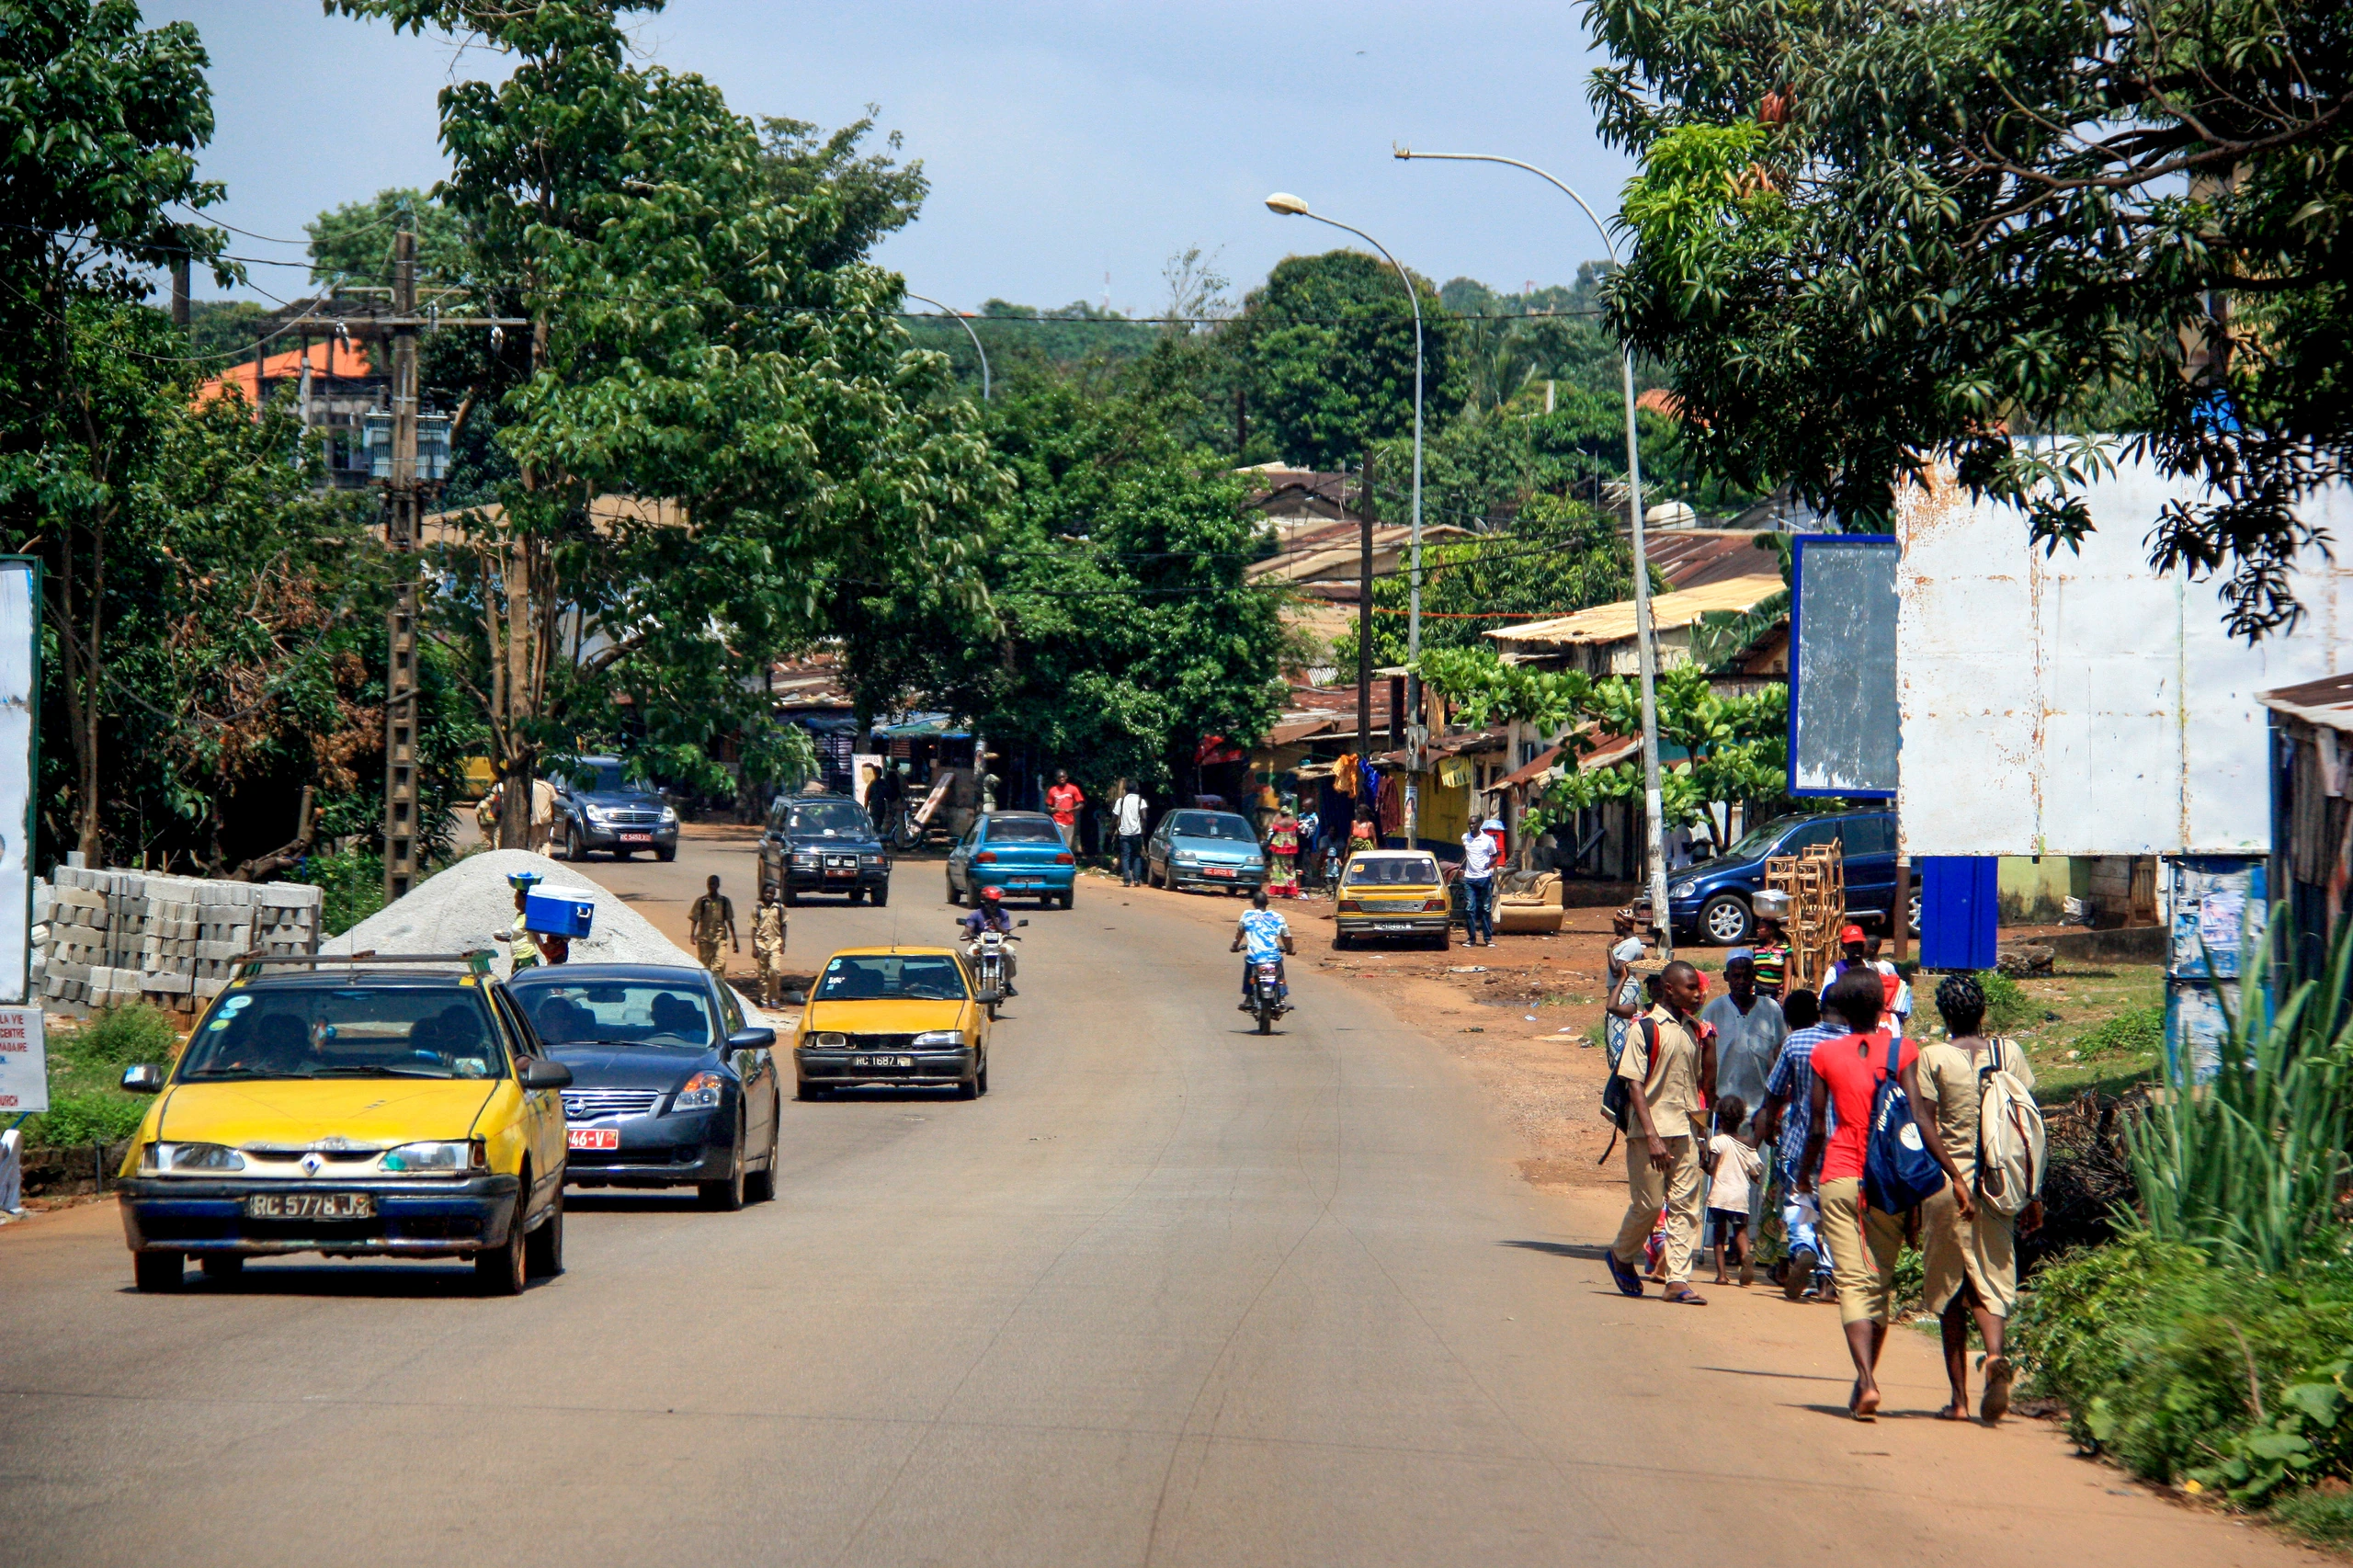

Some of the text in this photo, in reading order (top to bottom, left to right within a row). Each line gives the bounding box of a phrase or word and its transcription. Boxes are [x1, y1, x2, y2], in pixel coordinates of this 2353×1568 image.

[12, 1015, 24, 1025] VIE
[855, 1056, 869, 1065] RC
[872, 1056, 894, 1066] 1687
[254, 1195, 280, 1215] RC
[285, 1195, 335, 1215] 5778
